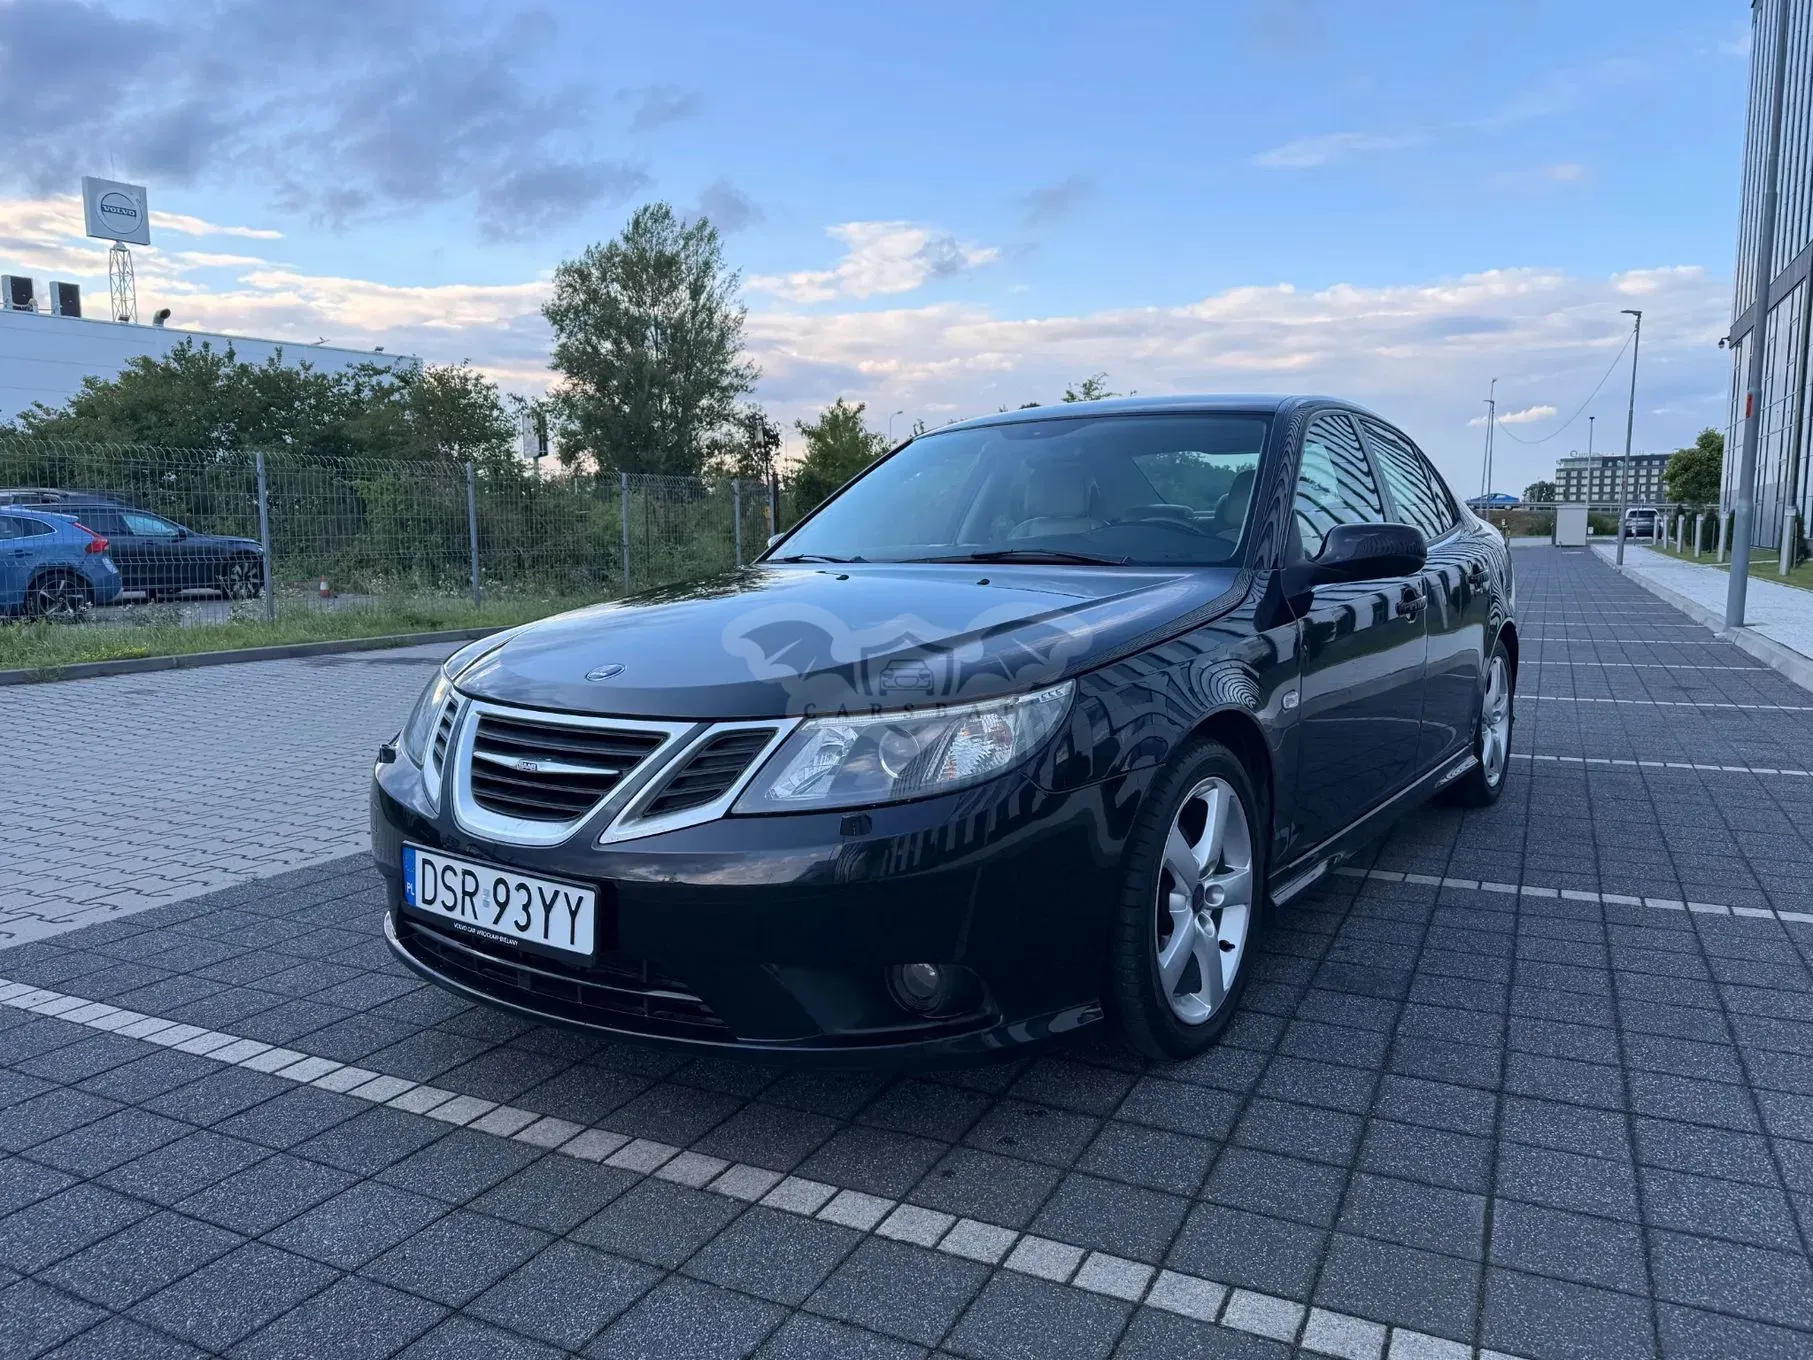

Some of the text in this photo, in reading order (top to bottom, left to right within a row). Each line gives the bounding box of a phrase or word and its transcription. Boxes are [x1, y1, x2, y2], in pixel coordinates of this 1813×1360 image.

[103, 205, 135, 216] VOLVO
[406, 882, 415, 896] PL
[421, 857, 584, 946] DSR 93YY
